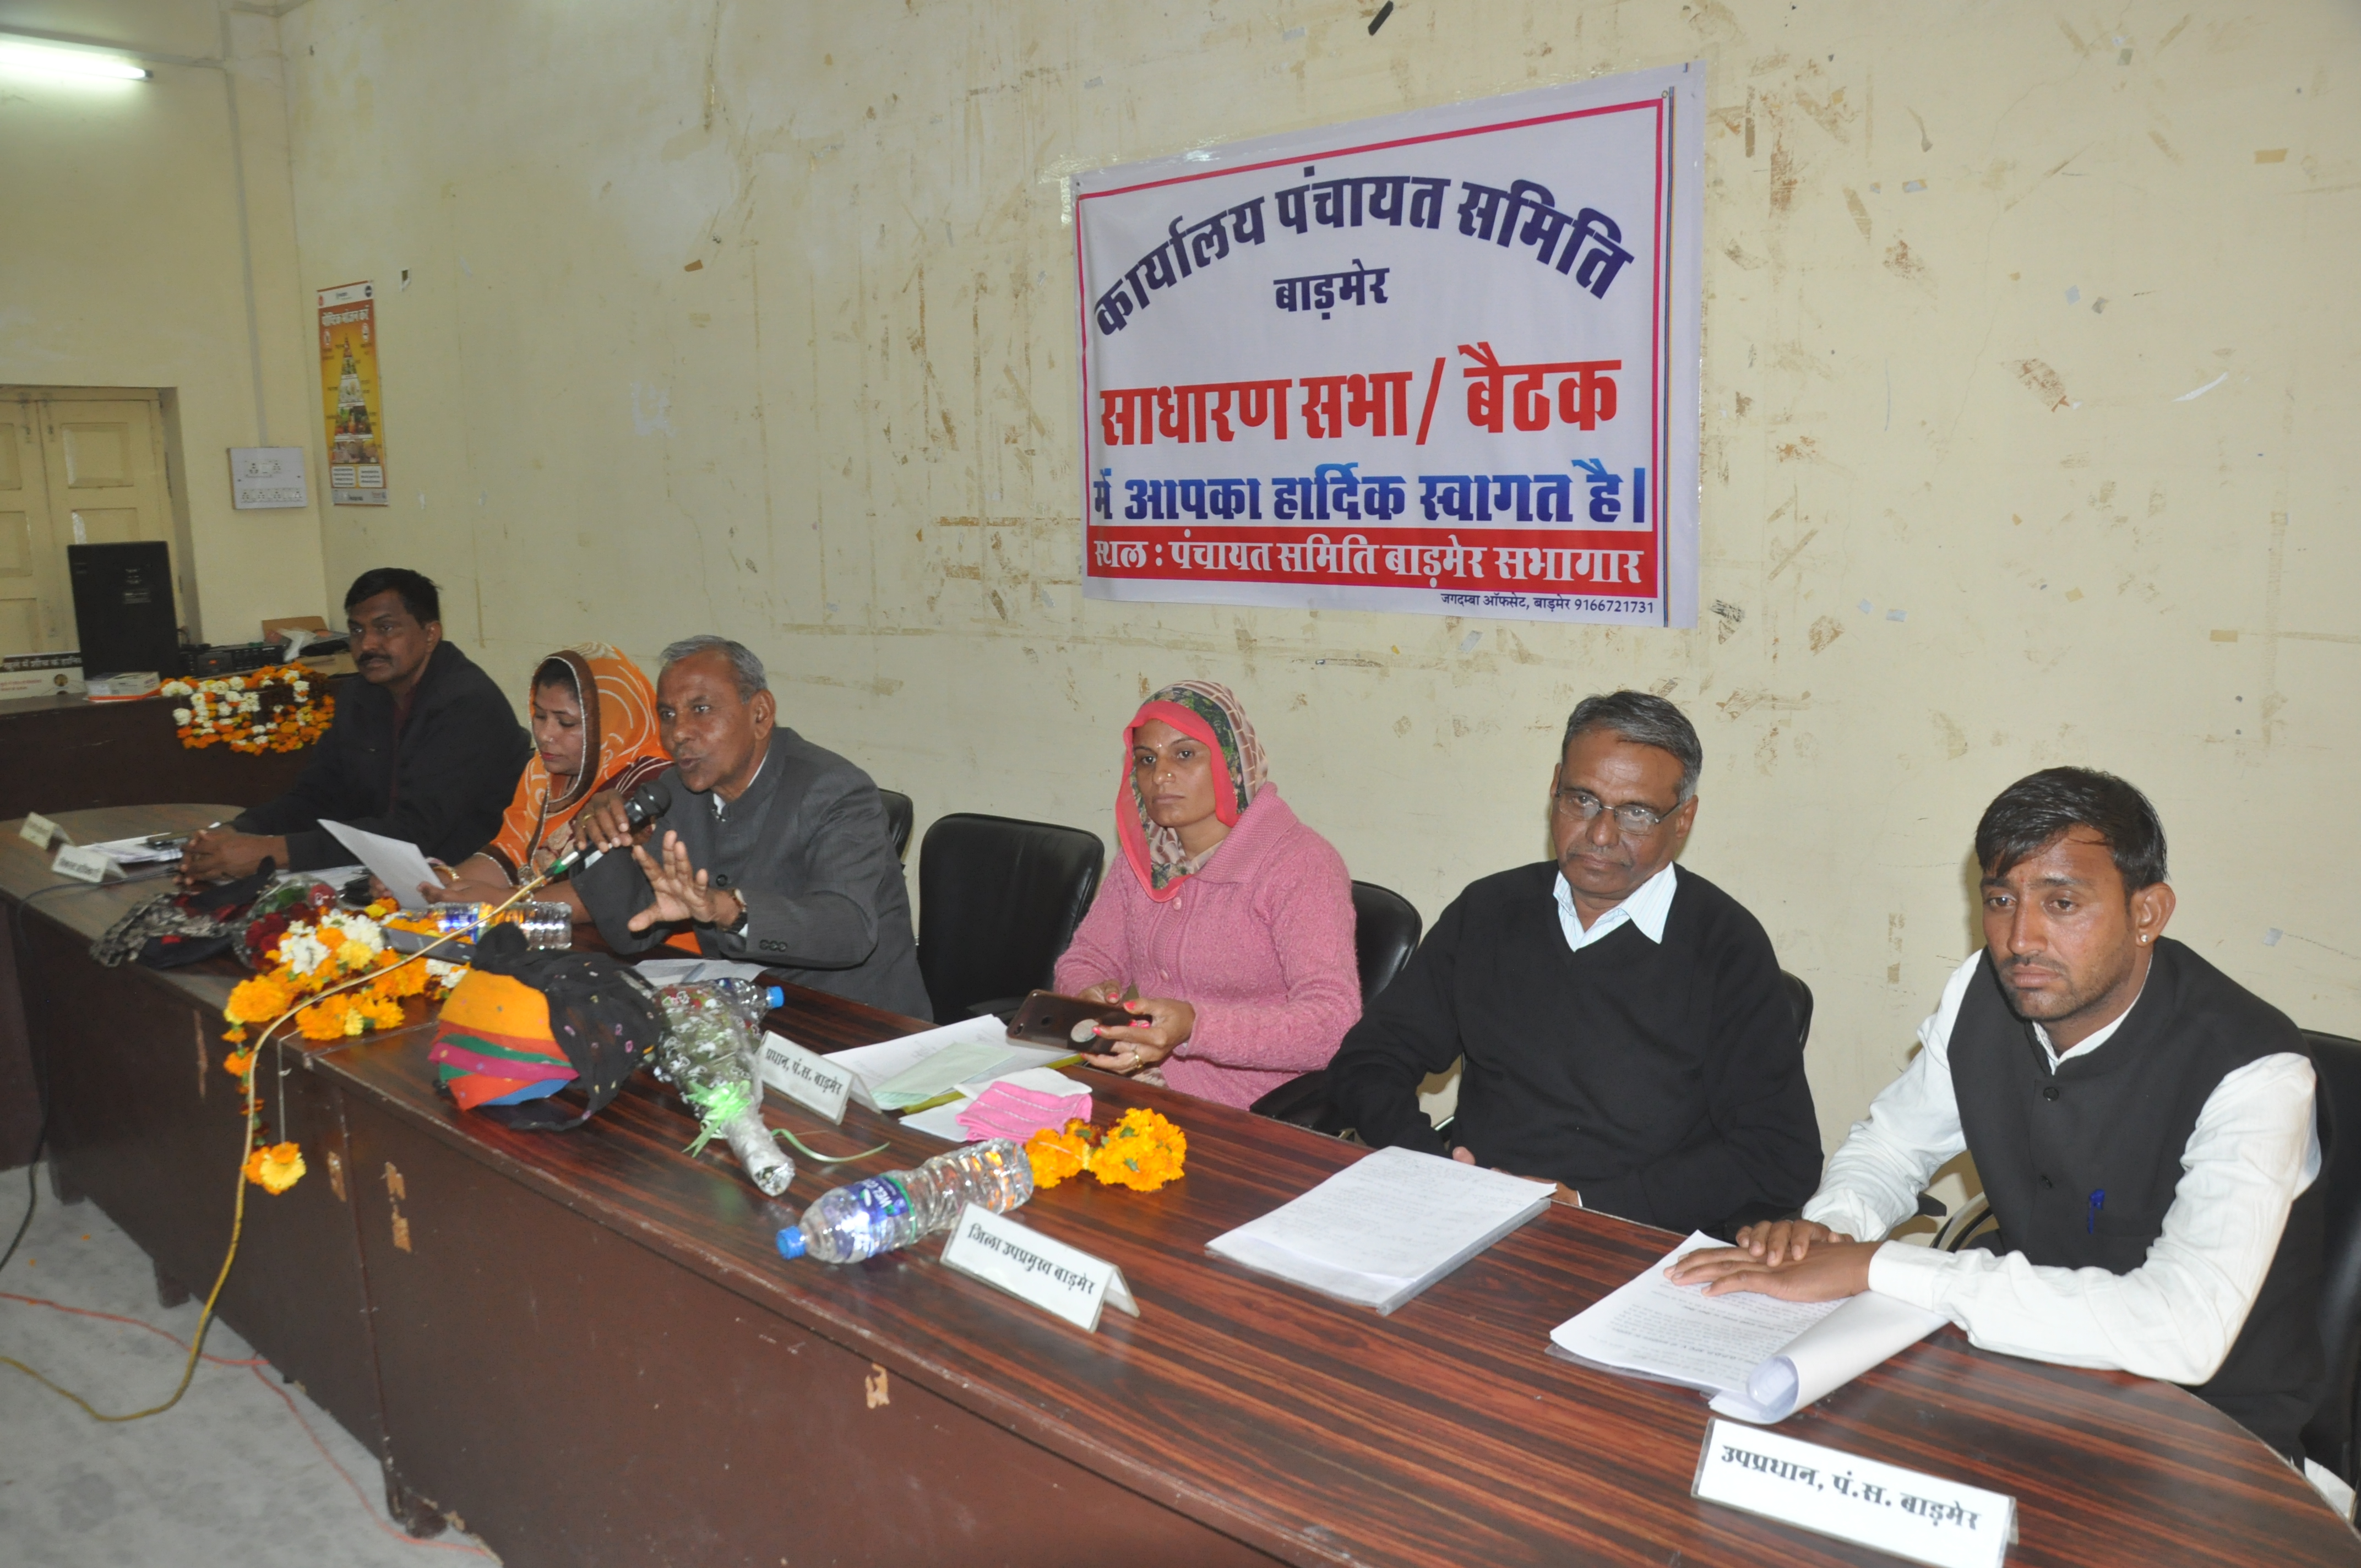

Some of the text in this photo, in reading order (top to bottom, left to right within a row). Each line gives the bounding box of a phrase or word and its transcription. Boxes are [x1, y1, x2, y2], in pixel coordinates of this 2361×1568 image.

[1092, 166, 1634, 336] कार्यालय पंचायत समिति
[1274, 259, 1389, 320] बाड़मेर
[1100, 378, 1291, 447] साधारण
[1300, 370, 1412, 445] सभा
[1457, 341, 1622, 433] बैठक
[1124, 477, 1262, 520] आपका
[1273, 462, 1405, 520] हार्दिक
[1419, 472, 1572, 522] स्वागत
[1094, 538, 1147, 569] स्थल
[1168, 528, 1272, 572] पंचायत
[1277, 535, 1380, 573] समिति
[1384, 535, 1486, 589] बाड़मेर
[1494, 547, 1642, 584] सभागार
[1440, 591, 1653, 613] जगदम्बा ऑफसेट, बाड़मेर 9166721731
[765, 1047, 790, 1071] प्रधान,
[814, 1071, 844, 1095] बाड़मेर
[967, 1223, 1096, 1295] जिला उपप्रमुख बाड़मेर
[1721, 1444, 1982, 1531] उपप्रधान, पं.स. बाड़मेर
